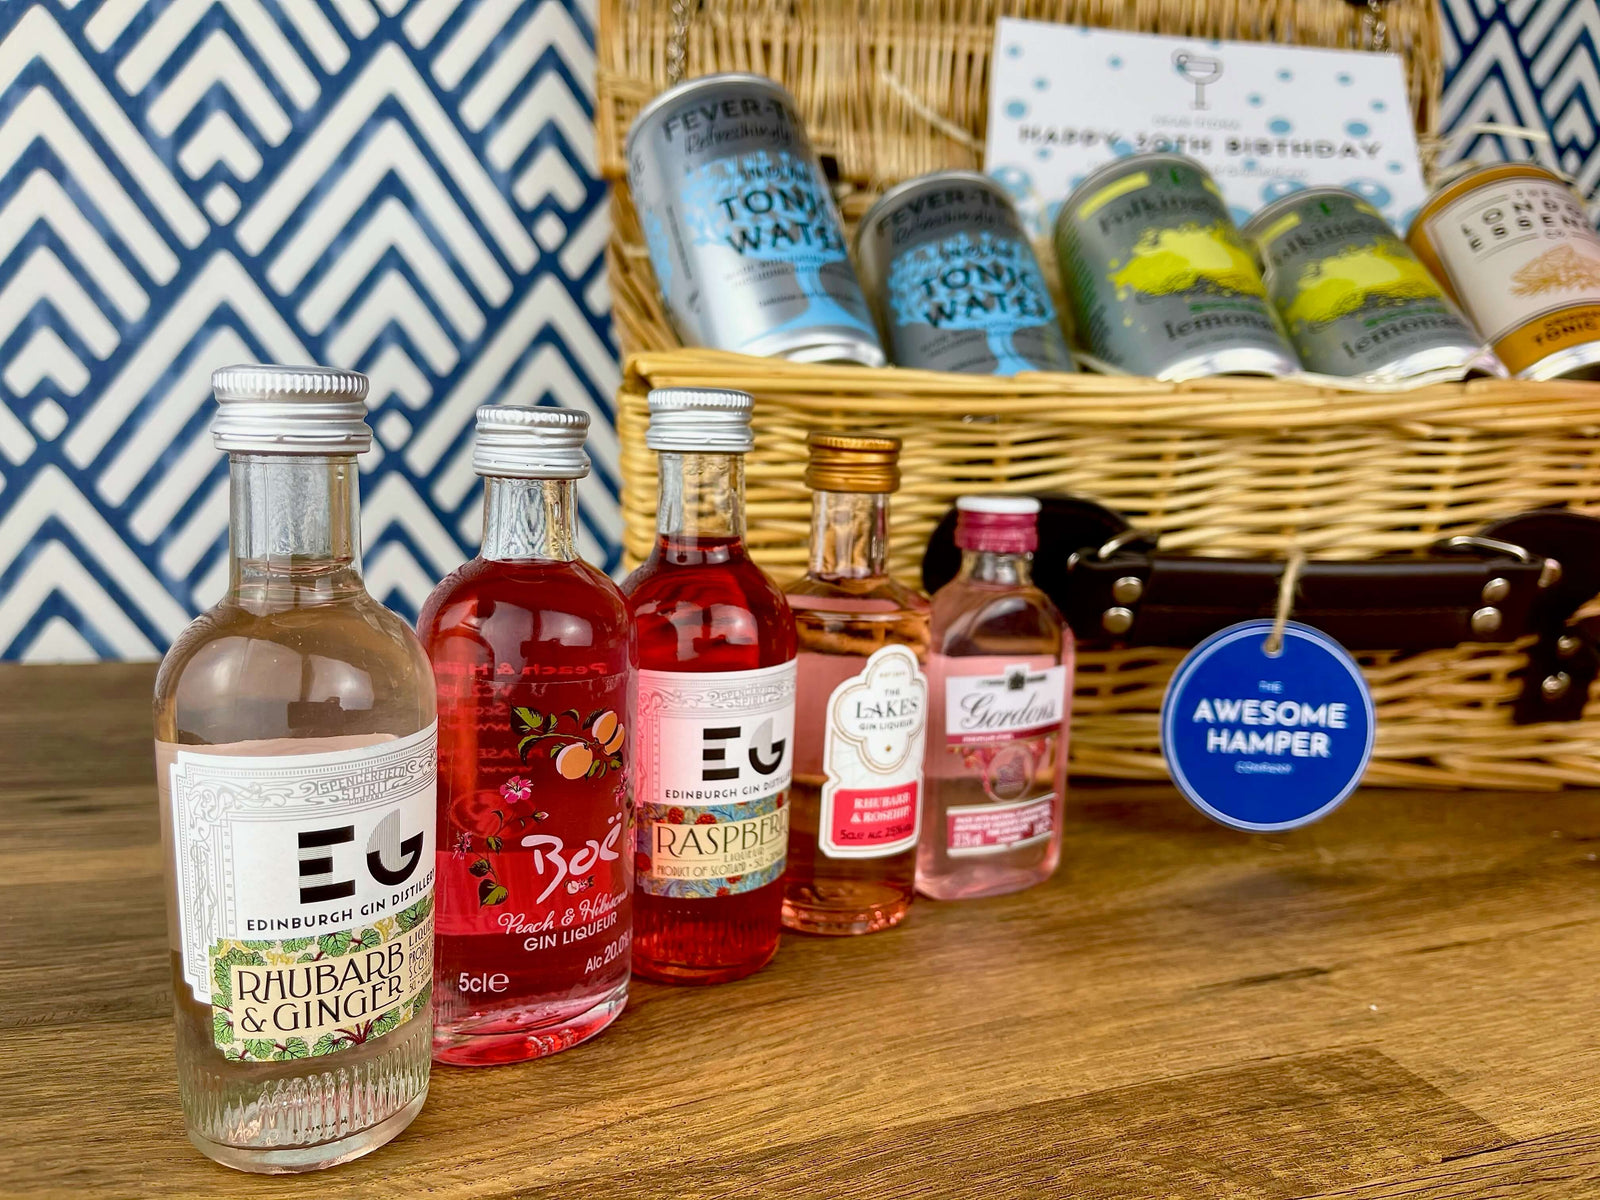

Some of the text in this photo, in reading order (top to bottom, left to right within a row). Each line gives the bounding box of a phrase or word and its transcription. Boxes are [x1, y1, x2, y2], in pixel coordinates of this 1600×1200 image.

[663, 97, 799, 142] FEVER-T
[1018, 125, 1121, 148] HAPPY
[1225, 136, 1382, 159] BIRTHDAY
[1461, 198, 1583, 237] LONDO
[856, 696, 919, 719] LAKES
[1192, 698, 1349, 729] AWESOME
[702, 716, 786, 781] EG
[1206, 728, 1332, 758] HAMPER
[665, 788, 738, 800] EDINBURGH
[742, 784, 761, 796] GIN
[657, 808, 789, 858] RASPBERR
[297, 808, 424, 905] EG
[657, 864, 690, 877] PRODUCT
[693, 866, 709, 877] OF
[247, 908, 353, 931] EDINBURGH
[360, 899, 386, 916] GIN
[497, 910, 555, 935] Peach
[561, 907, 576, 927] &
[523, 911, 618, 952] GIN LIQUEUR
[237, 941, 404, 1002] RHUBARB
[584, 956, 603, 975] Alc
[240, 974, 404, 1033] & GINGER
